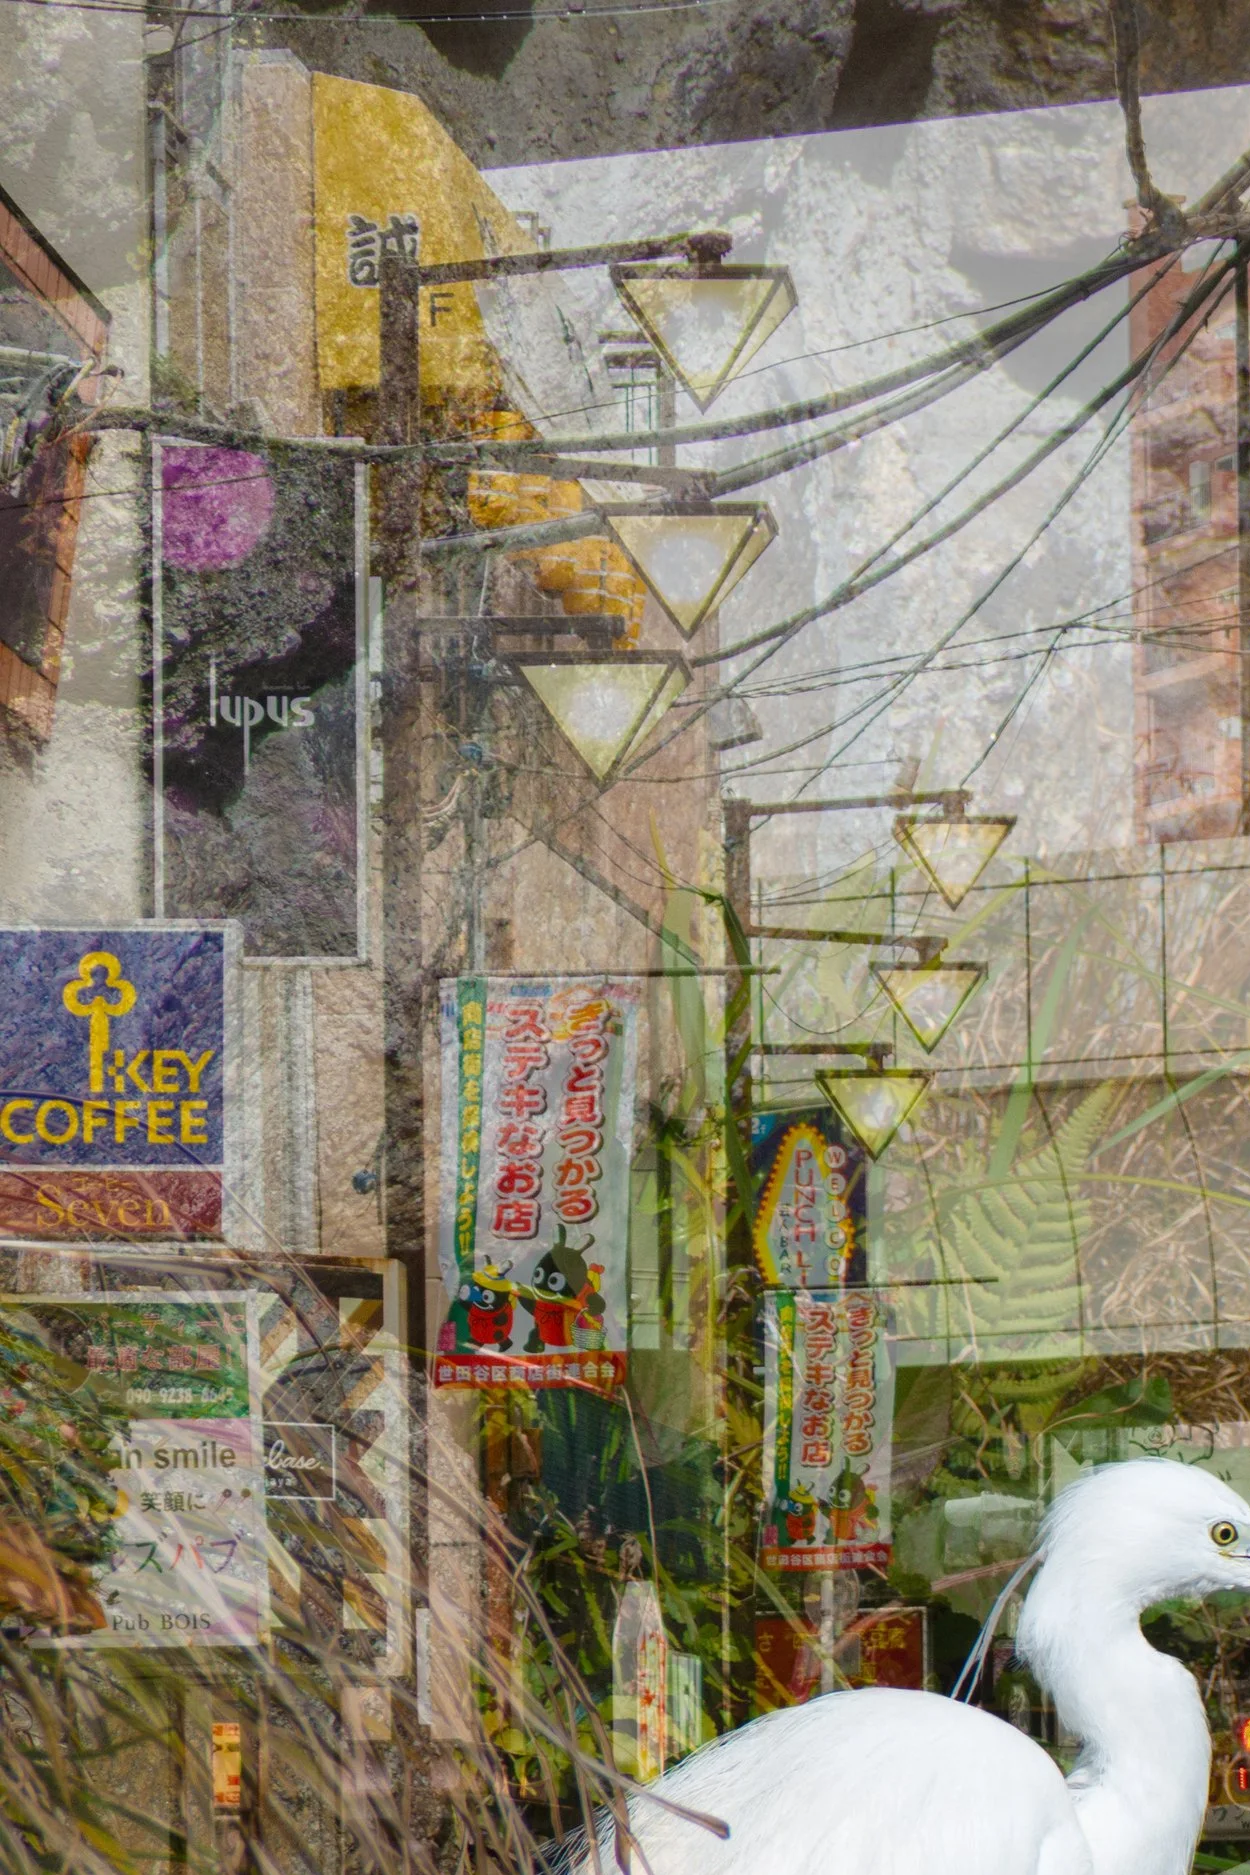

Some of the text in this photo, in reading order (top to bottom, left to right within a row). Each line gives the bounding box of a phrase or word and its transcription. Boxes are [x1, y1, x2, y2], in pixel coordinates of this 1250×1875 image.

[210, 658, 315, 776] lupus
[107, 1049, 215, 1094] KEY
[553, 999, 608, 1217] きっと見つかる
[0, 1099, 209, 1145] COFFEE
[492, 1005, 547, 1236] ステキなお店
[35, 1183, 172, 1228] Seven
[794, 1149, 816, 1242] PUNCH
[801, 1308, 834, 1466] ステキなお店
[843, 1306, 875, 1455] きっと見つかる
[154, 1440, 237, 1469] smile
[112, 1612, 211, 1631] Pub BOIS
